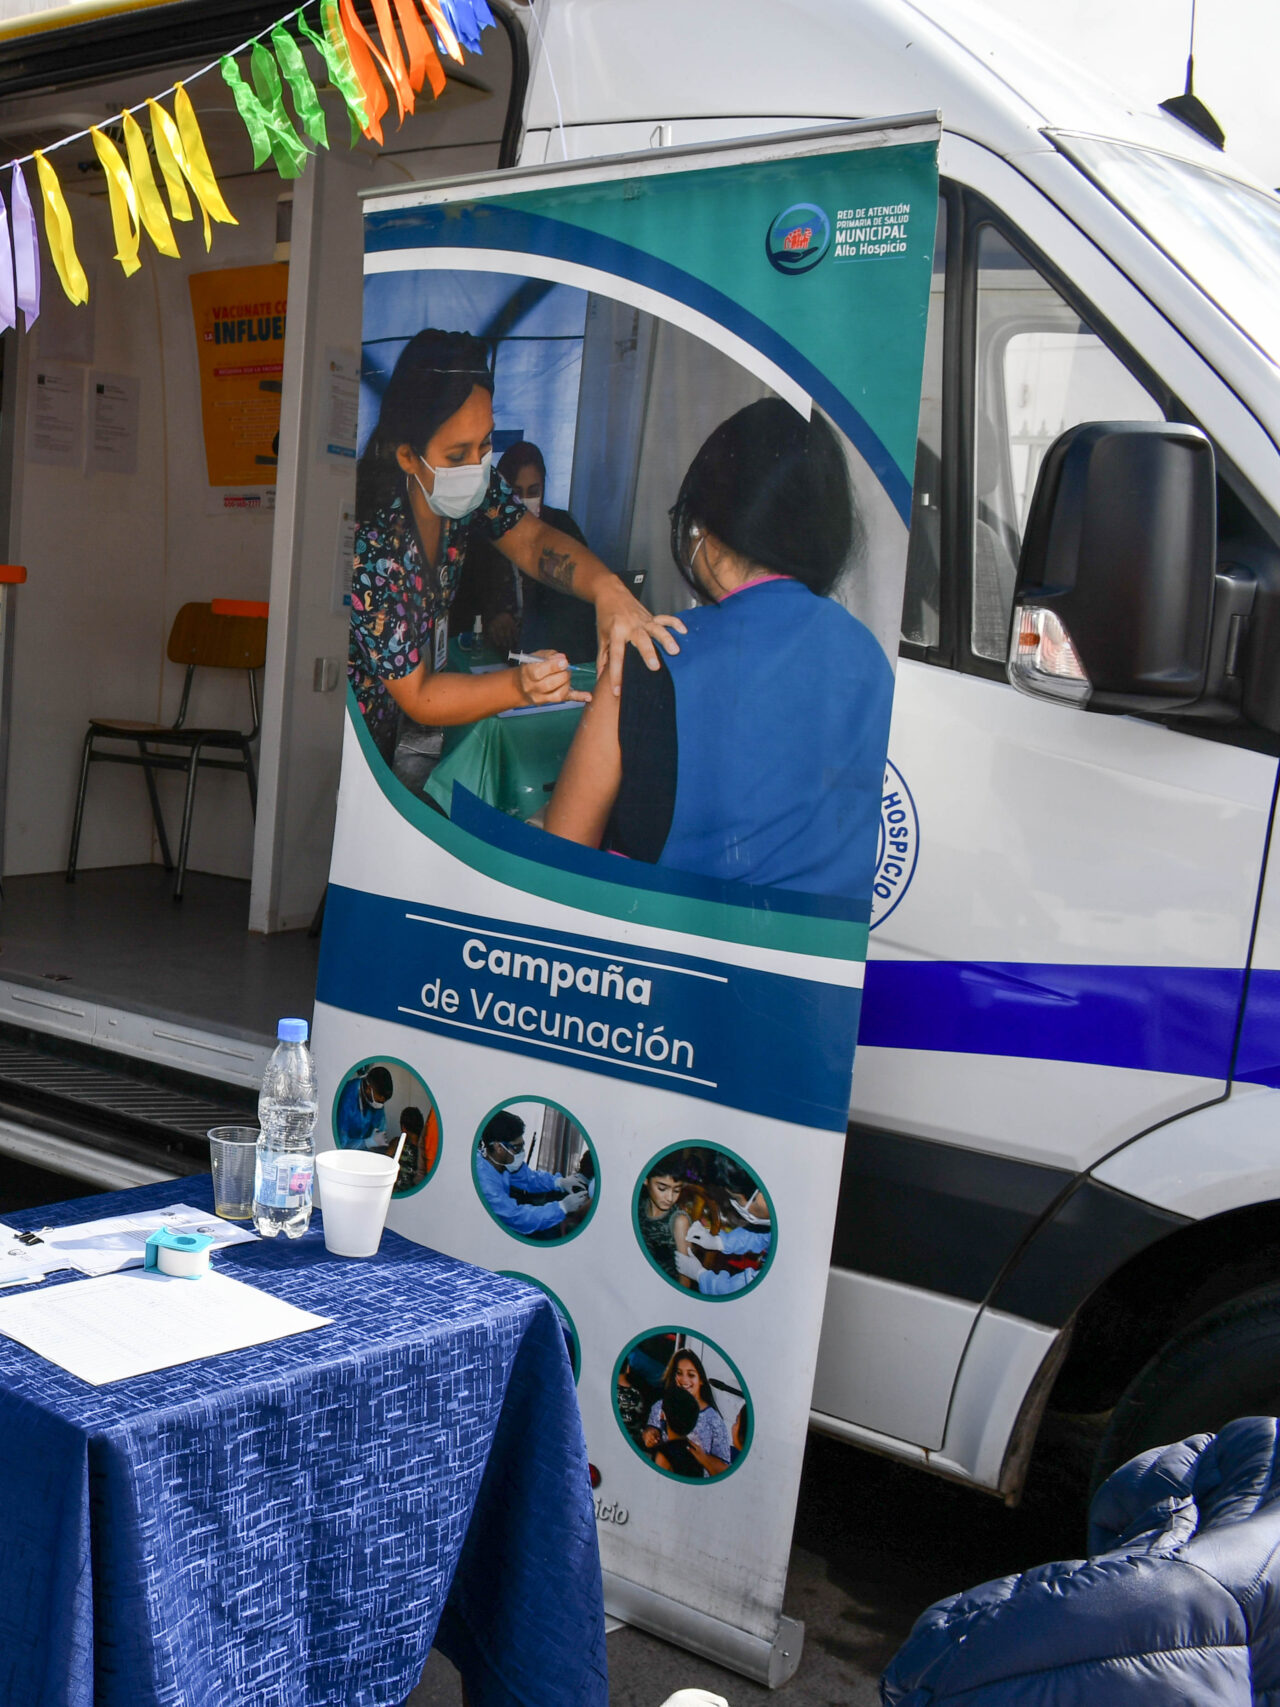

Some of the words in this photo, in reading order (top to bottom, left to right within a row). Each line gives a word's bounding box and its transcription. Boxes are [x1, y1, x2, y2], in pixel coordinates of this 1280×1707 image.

[836, 219, 871, 228] PRIMARIA
[873, 217, 882, 226] DE
[884, 215, 909, 225] SALUD
[837, 209, 853, 220] RED
[856, 208, 866, 218] DE
[868, 202, 910, 216] ATENCIÓN
[835, 225, 907, 244] MUNICIPAL
[834, 244, 856, 257] Alto
[859, 240, 907, 256] Hospicio
[214, 317, 286, 345] INFLUE
[874, 791, 908, 900] HOSPICIO
[462, 939, 652, 1006] Campaña
[421, 978, 460, 1013] de
[470, 988, 694, 1069] Vacunación
